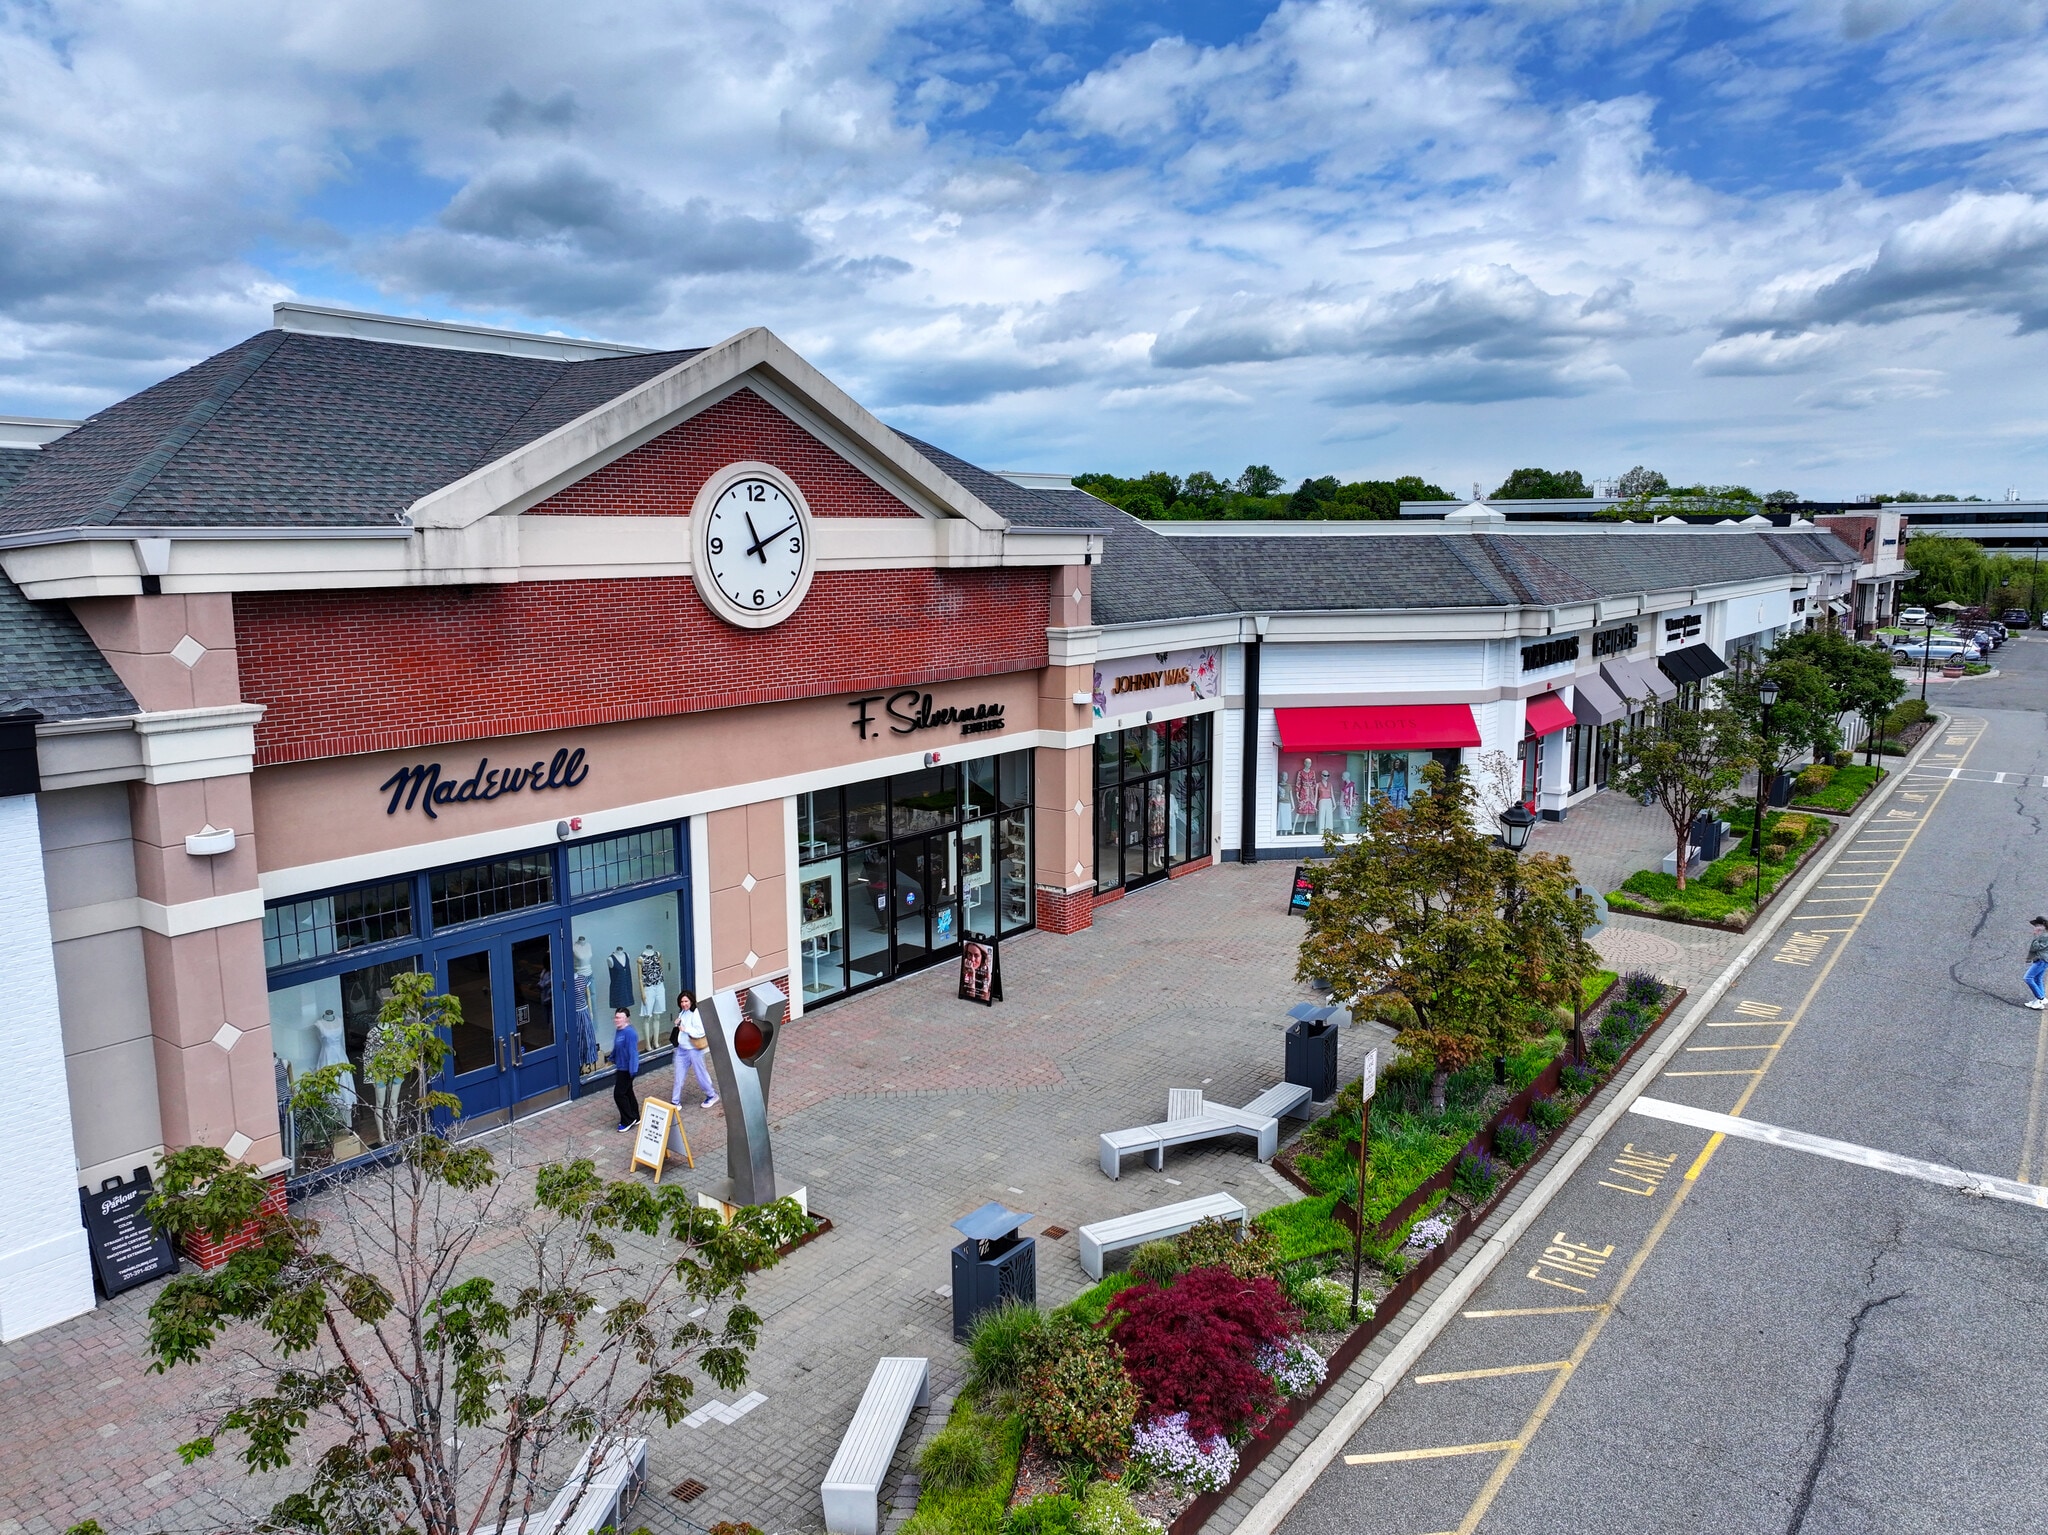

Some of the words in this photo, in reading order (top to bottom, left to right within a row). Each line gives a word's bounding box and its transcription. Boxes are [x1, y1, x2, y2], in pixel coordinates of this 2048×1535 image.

[747, 485, 766, 502] 12
[710, 537, 723, 555] 9
[789, 537, 801, 554] 3
[752, 589, 765, 606] 6
[1111, 671, 1163, 695] JOHNNY
[1164, 667, 1190, 686] WAS
[886, 690, 1005, 734] Silverman
[1340, 719, 1417, 730] TALBOTS
[380, 748, 589, 819] Madewell
[1772, 931, 1830, 967] PARKING
[101, 1190, 138, 1215] Parlour
[118, 1220, 133, 1229] COLOR
[1526, 1231, 1616, 1294] FIRE
[1599, 1143, 1678, 1197] LANE
